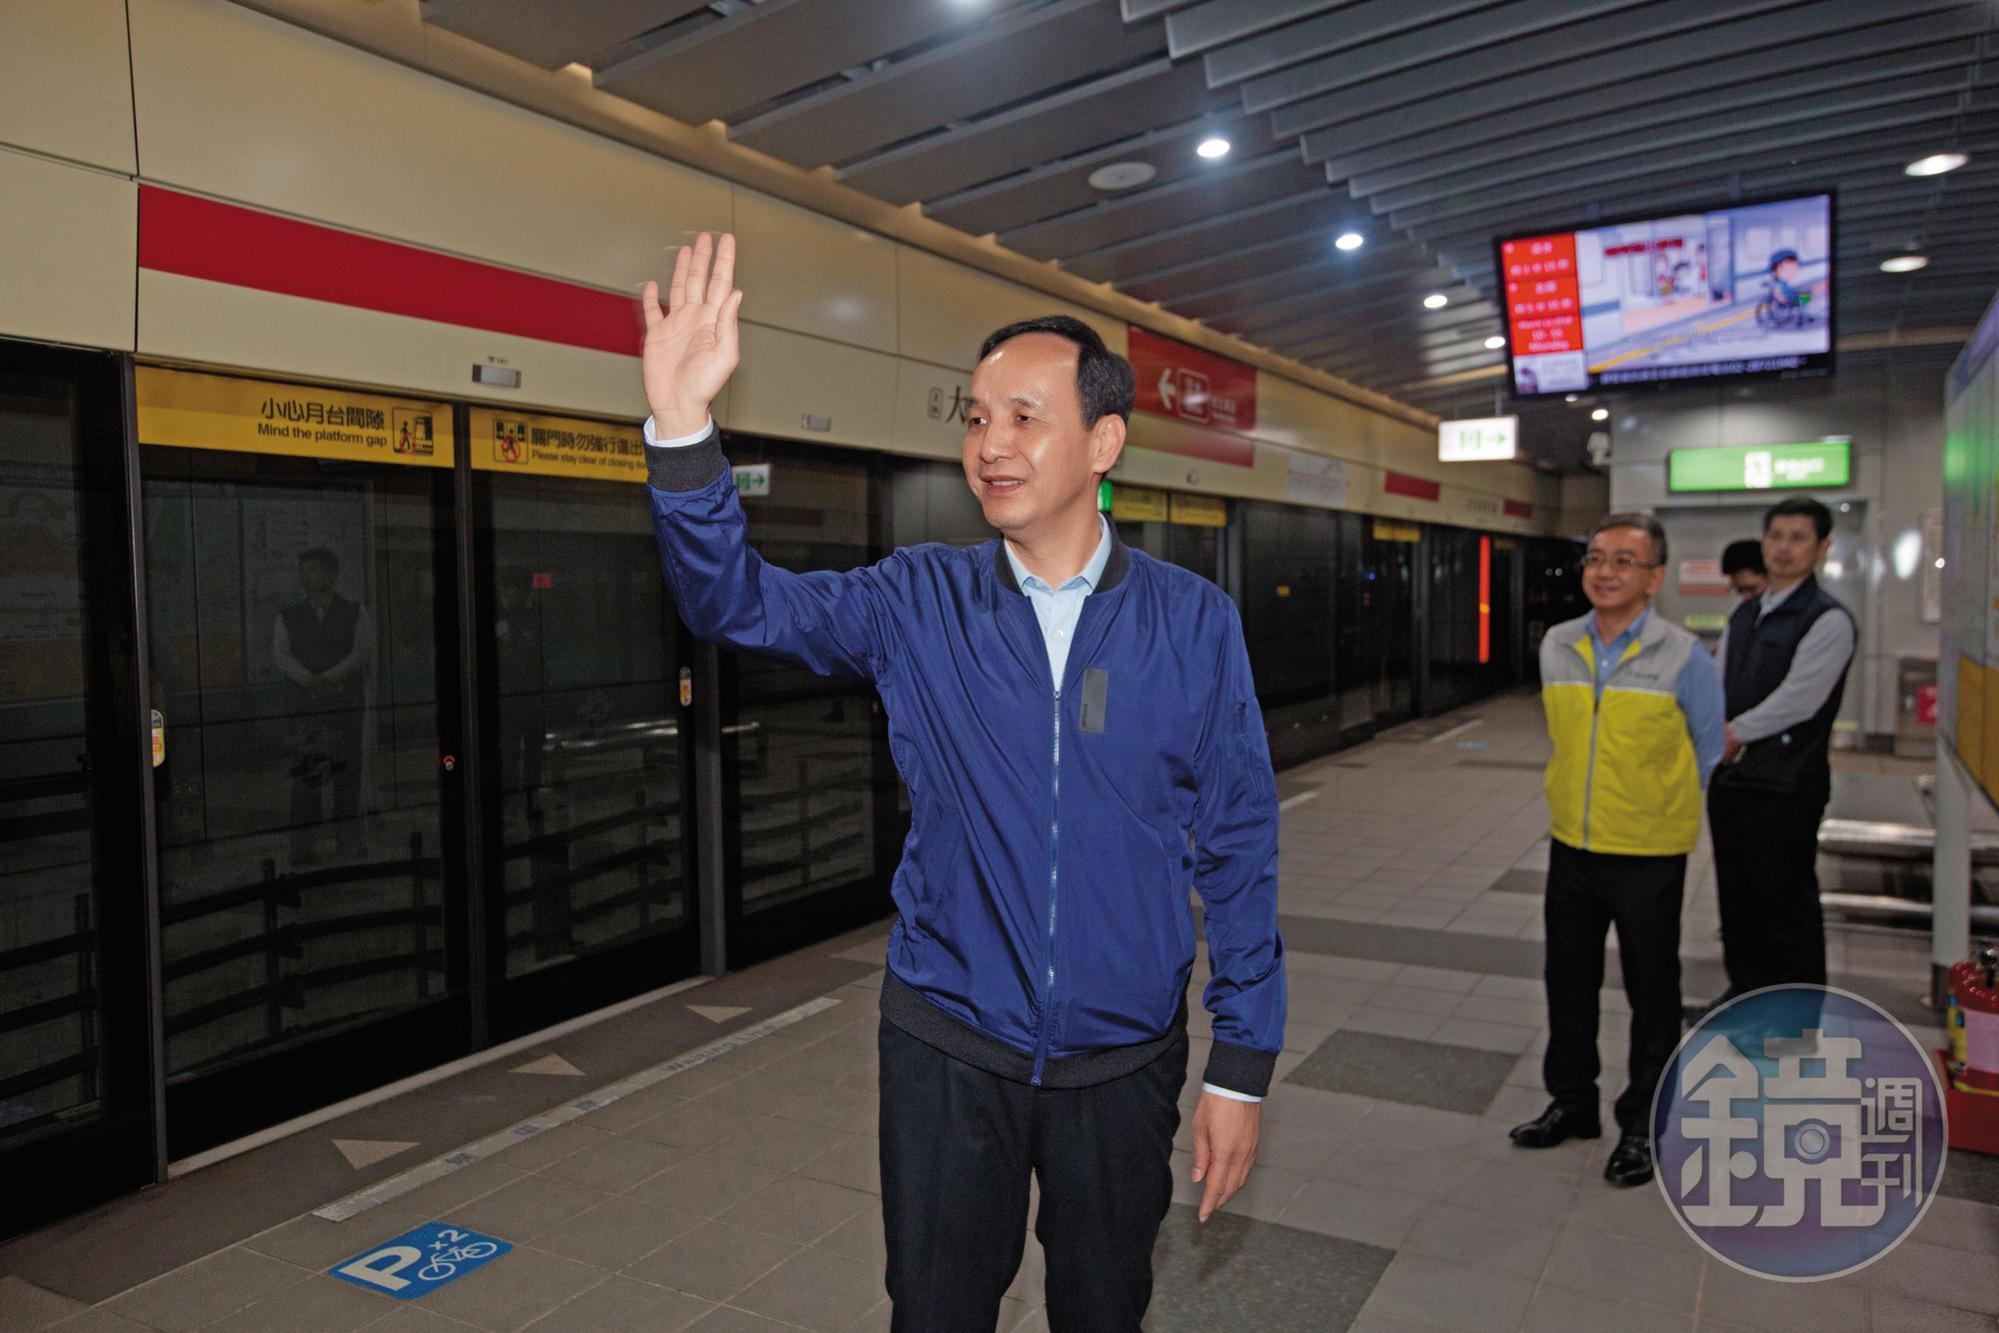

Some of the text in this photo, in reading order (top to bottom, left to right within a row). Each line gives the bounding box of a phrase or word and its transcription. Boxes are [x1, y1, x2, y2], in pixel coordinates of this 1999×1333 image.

[260, 397, 385, 431] 小心月台間隙
[257, 423, 387, 447] Mind the platform gap
[532, 448, 558, 461] Please
[559, 454, 577, 465] stay
[578, 455, 597, 465] clear
[607, 458, 634, 471] closing
[338, 1245, 422, 1291] P
